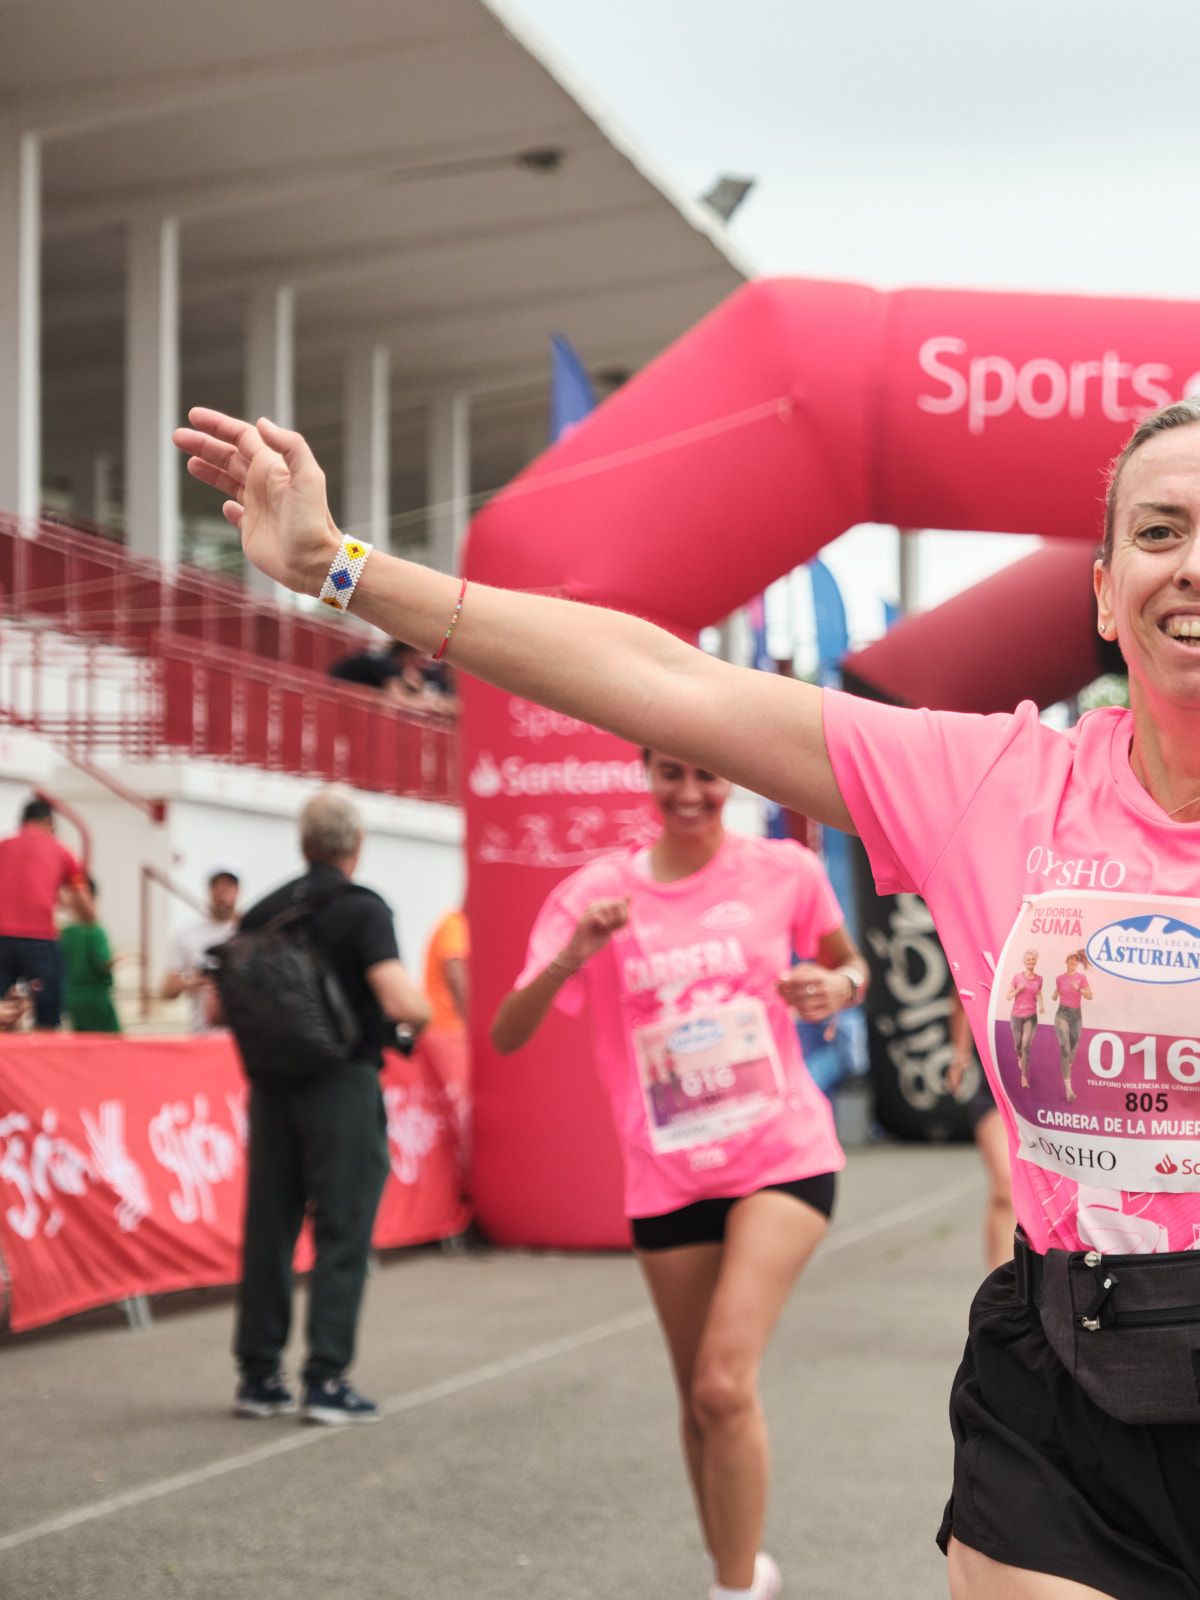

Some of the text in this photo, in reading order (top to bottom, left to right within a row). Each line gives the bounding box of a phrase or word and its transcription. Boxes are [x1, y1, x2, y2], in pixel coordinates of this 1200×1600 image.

[916, 335, 1173, 437] Sports
[1026, 845, 1126, 888] OYSHO
[1034, 907, 1084, 919] TU DORSAL
[1030, 919, 1082, 937] SUMA
[1118, 935, 1161, 946] CENTRAL
[1087, 1079, 1122, 1089] TELÉFONO
[1122, 1082, 1160, 1090] VIOLENCIA
[1125, 1092, 1168, 1113] 805
[1037, 1109, 1100, 1131] CARRERA
[1104, 1117, 1123, 1133] DE
[1127, 1119, 1146, 1134] LA
[1039, 1137, 1117, 1171] OYSHO
